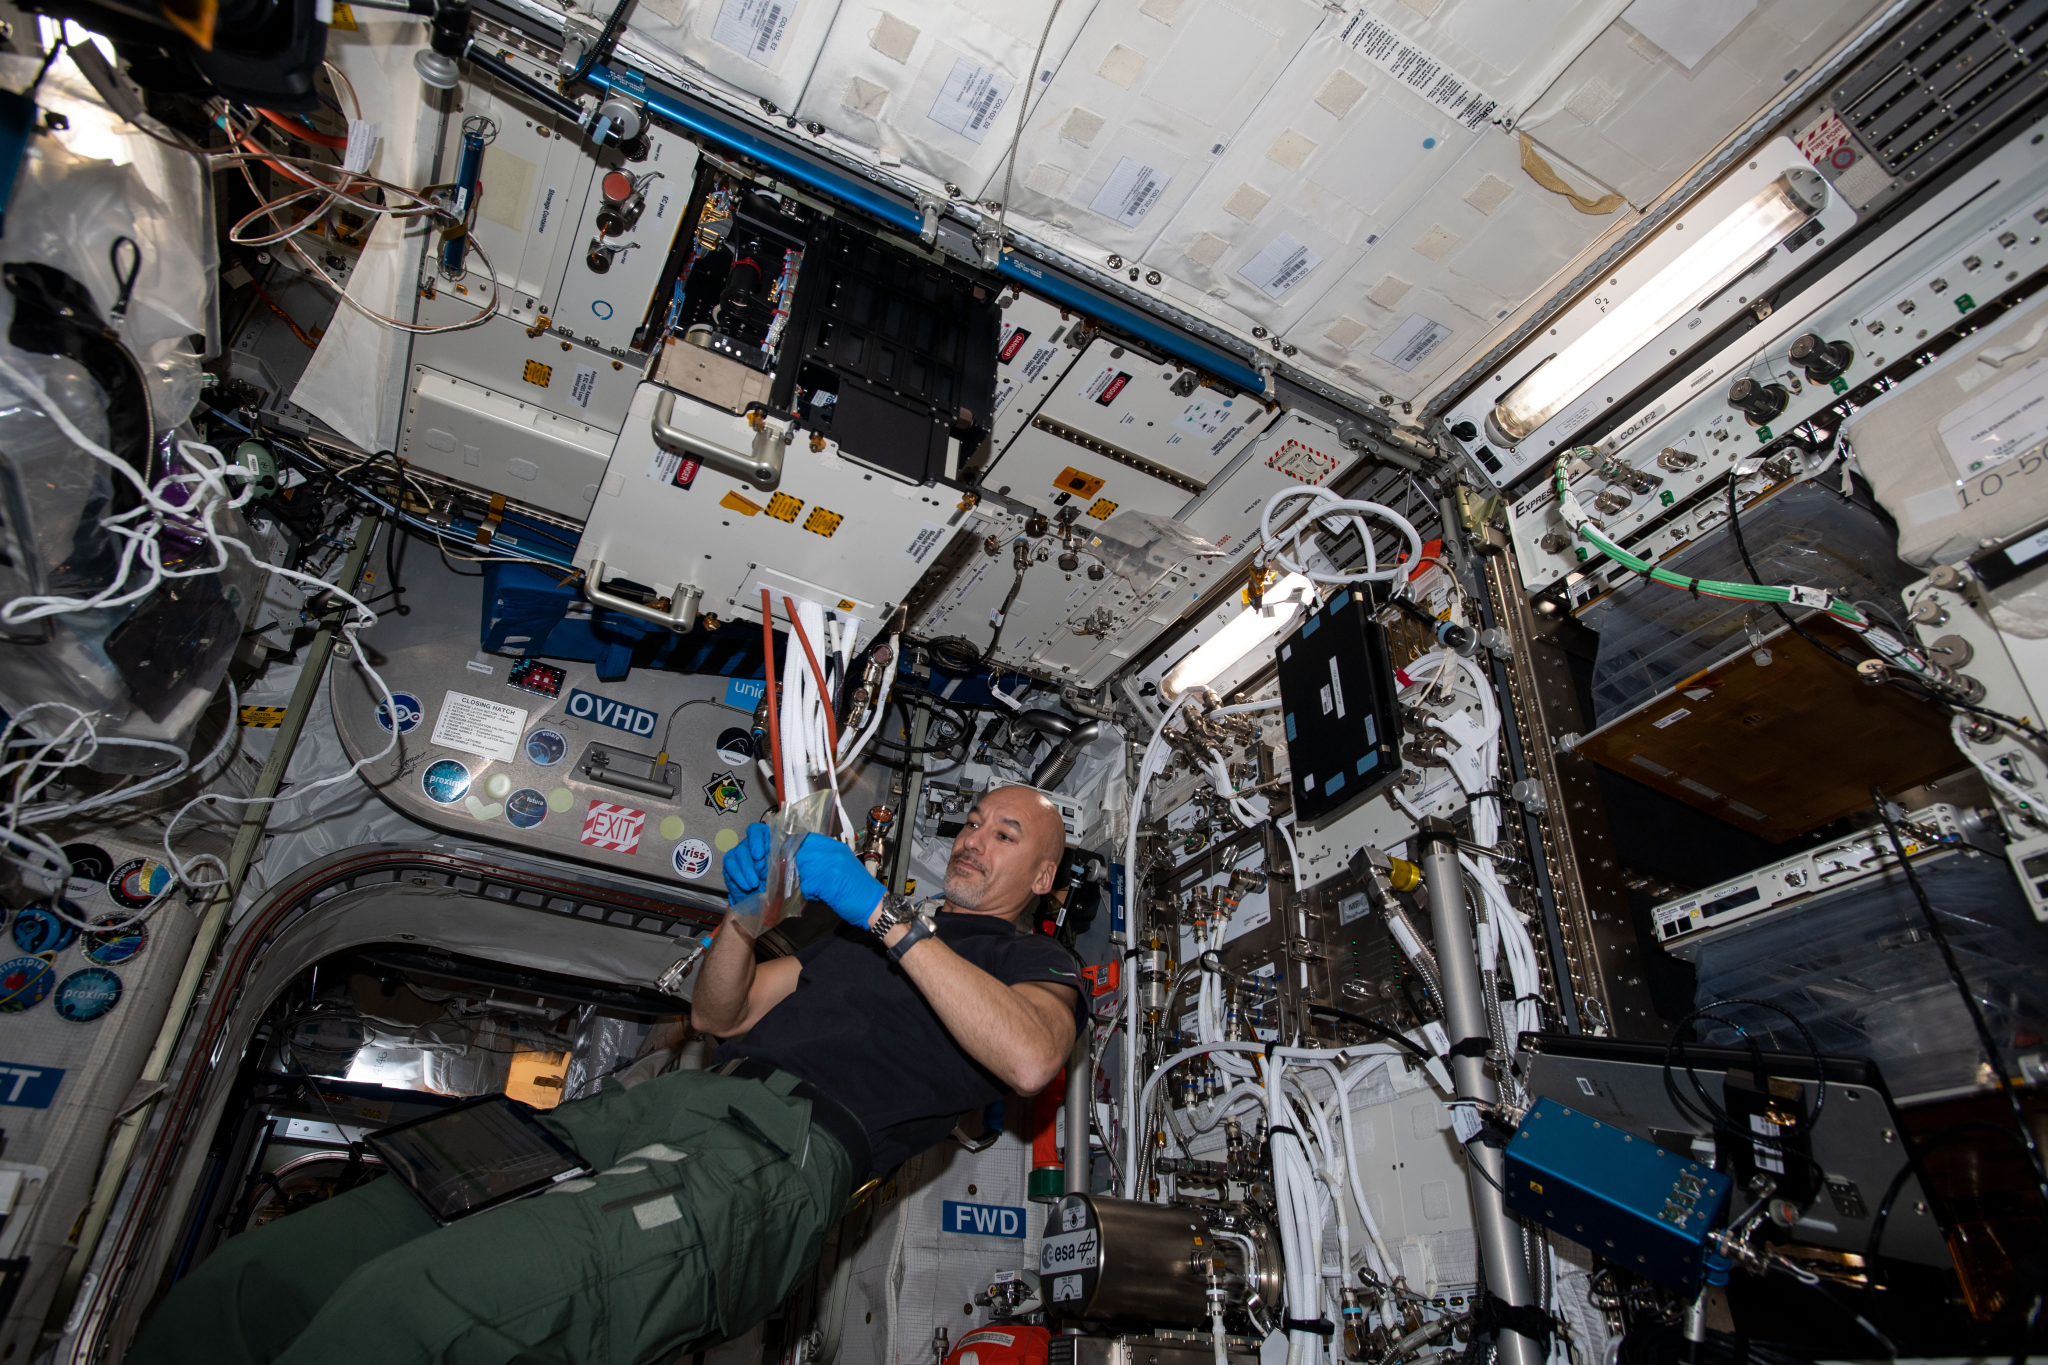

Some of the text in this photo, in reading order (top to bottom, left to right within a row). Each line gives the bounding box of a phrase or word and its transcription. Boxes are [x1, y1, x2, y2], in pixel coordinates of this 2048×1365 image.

[1480, 100, 1497, 118] ZSR
[1831, 120, 1839, 128] USE
[1809, 124, 1845, 153] FIRE PORT
[868, 171, 877, 179] D
[537, 188, 555, 234] Stowage Container
[655, 195, 668, 218] EC panel
[1035, 250, 1044, 259] C
[1003, 335, 1022, 357] DANGER
[1021, 347, 1043, 374] (CEM Upper)
[1026, 349, 1048, 377] Module Upper
[1027, 346, 1058, 384] Central Experiment
[569, 373, 583, 397] behind panel
[588, 370, 597, 384] Avionic
[1104, 378, 1123, 399] DANGER
[1619, 411, 1657, 440] COL1F2
[1212, 437, 1232, 457] Diagnostic
[680, 458, 695, 481] DANGER
[1957, 442, 2048, 510] 1.0-5
[1511, 485, 1553, 518] EXPRES
[905, 528, 927, 554] (CEM Lower)
[911, 529, 934, 557] Module Lower
[914, 527, 944, 564] Central Experiment
[461, 697, 516, 716] CLOSING HATCH
[570, 693, 655, 735] OVHD
[541, 730, 560, 740] volare
[430, 775, 464, 788] proxim
[526, 796, 544, 806] futura
[591, 812, 635, 843] EXIT
[682, 845, 705, 860] iriss
[110, 862, 137, 885] beyond
[61, 883, 88, 893] orizons
[63, 988, 117, 1001] proxima
[371, 1049, 388, 1075] 4146
[955, 1208, 1019, 1236] FWD
[1053, 1243, 1076, 1262] esa
